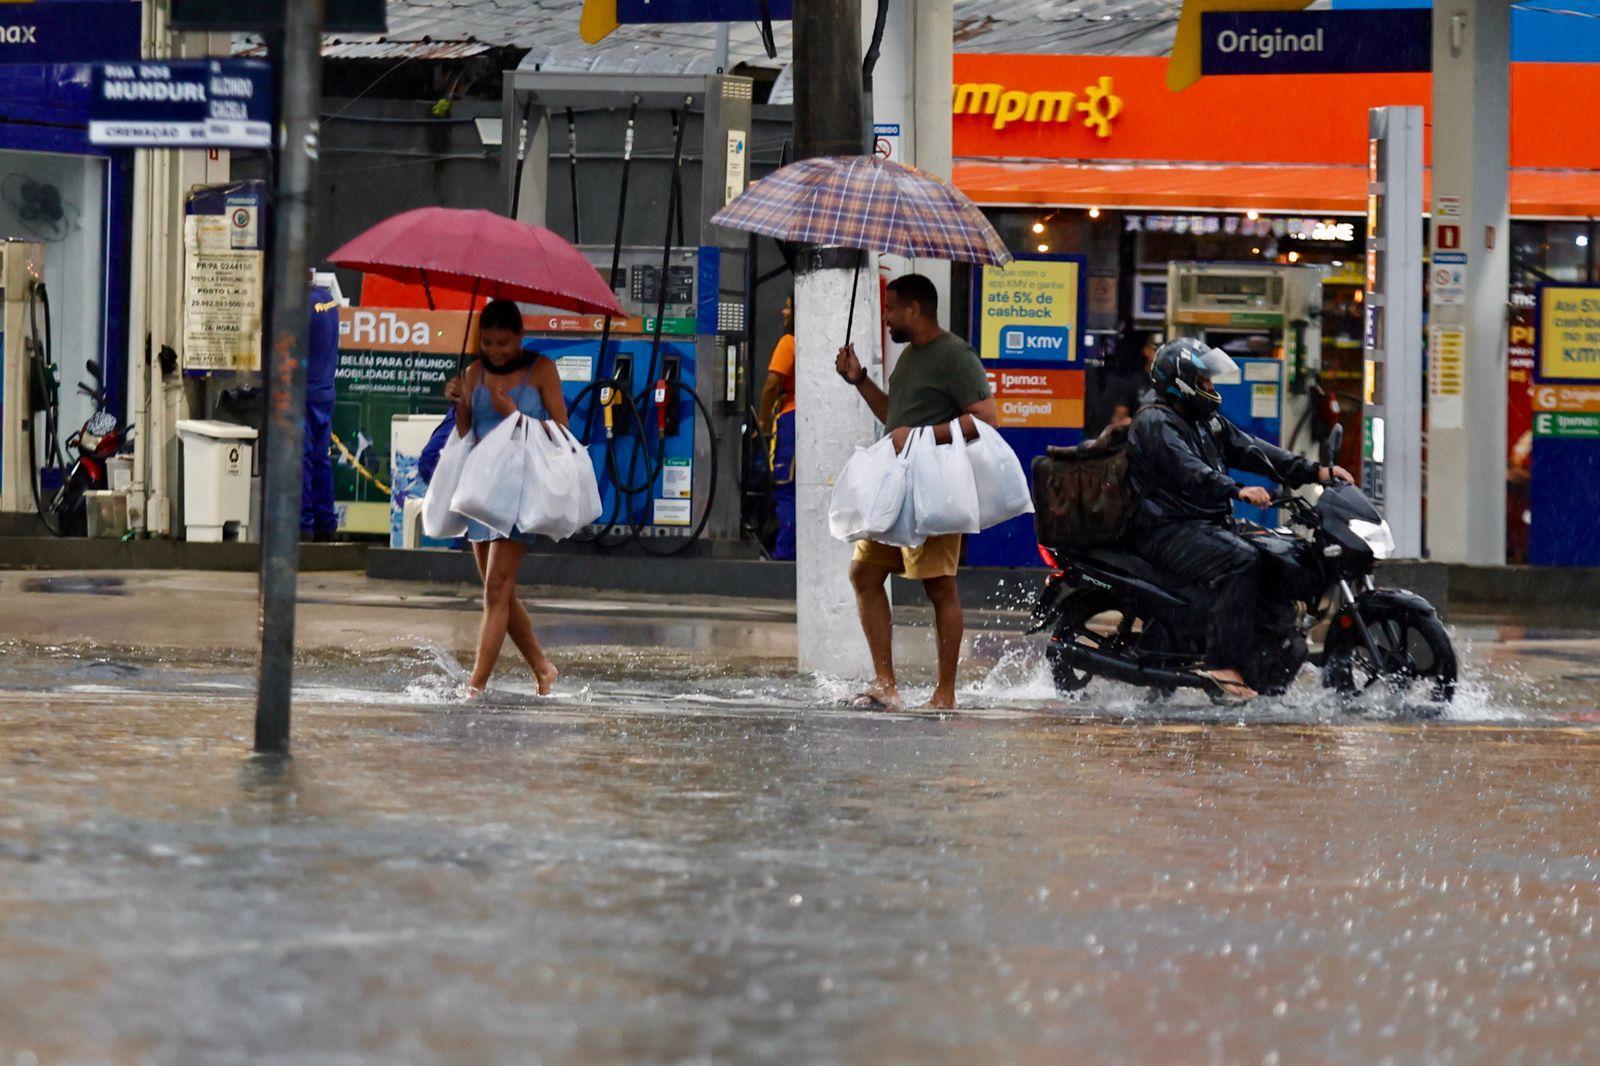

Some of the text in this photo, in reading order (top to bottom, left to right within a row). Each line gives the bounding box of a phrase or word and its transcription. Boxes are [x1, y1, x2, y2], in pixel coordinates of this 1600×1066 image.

[0, 25, 37, 43] ax
[1217, 28, 1324, 58] Original
[104, 64, 171, 80] RUA DOS
[988, 291, 1053, 304] até 5% de
[988, 305, 1052, 318] cashback
[549, 318, 559, 329] G
[594, 319, 604, 330] G
[645, 318, 655, 332] E
[340, 355, 374, 366] BELÉM
[375, 357, 402, 367] PARA
[334, 367, 447, 382] MOBILIDADE ELÉTRICA
[1001, 373, 1047, 387] Ipimax
[1537, 388, 1557, 409] G
[1002, 402, 1052, 417] Original
[1536, 414, 1552, 434] E
